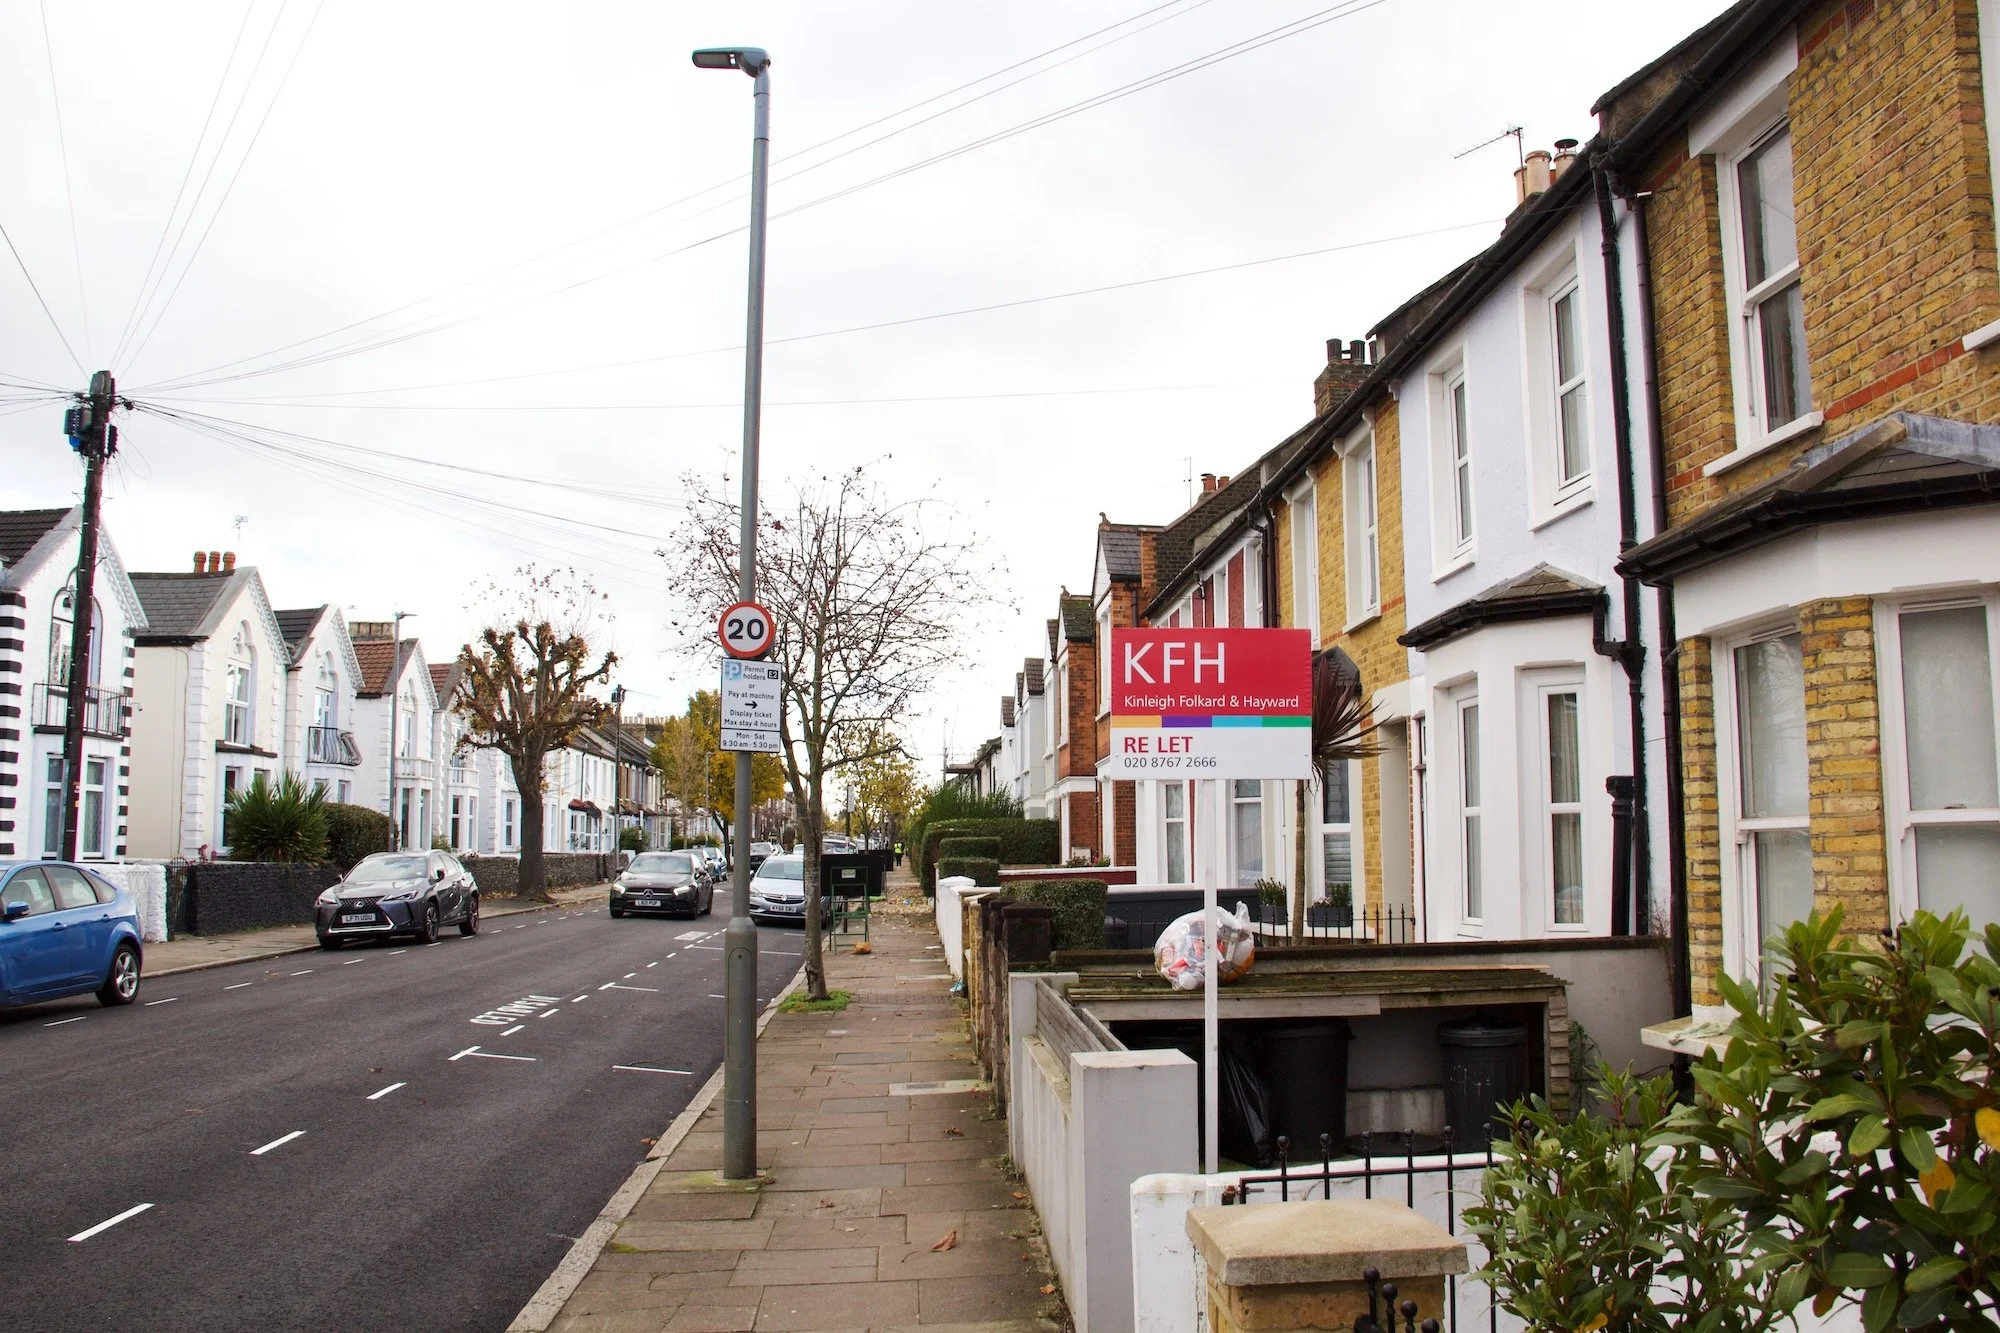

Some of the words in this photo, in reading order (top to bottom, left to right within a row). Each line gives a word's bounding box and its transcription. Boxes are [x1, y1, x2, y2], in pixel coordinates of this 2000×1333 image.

[728, 618, 764, 640] 20
[744, 665, 764, 673] Permit
[1124, 642, 1225, 684] KFH
[728, 690, 739, 698] Pay
[1124, 695, 1175, 710] Kinleigh
[1179, 695, 1225, 708] Folkard
[1229, 696, 1239, 707] &
[1243, 695, 1299, 711] Hayward
[730, 709, 752, 718] Display
[754, 711, 772, 719] ticket
[724, 718, 737, 726] Max
[739, 720, 752, 728] stay
[1124, 736, 1149, 753] RE
[1157, 736, 1193, 753] LET
[1124, 757, 1147, 768] 020
[1151, 757, 1181, 768] 8767
[1186, 757, 1217, 768] 2666
[469, 995, 561, 1025] DISABLED
